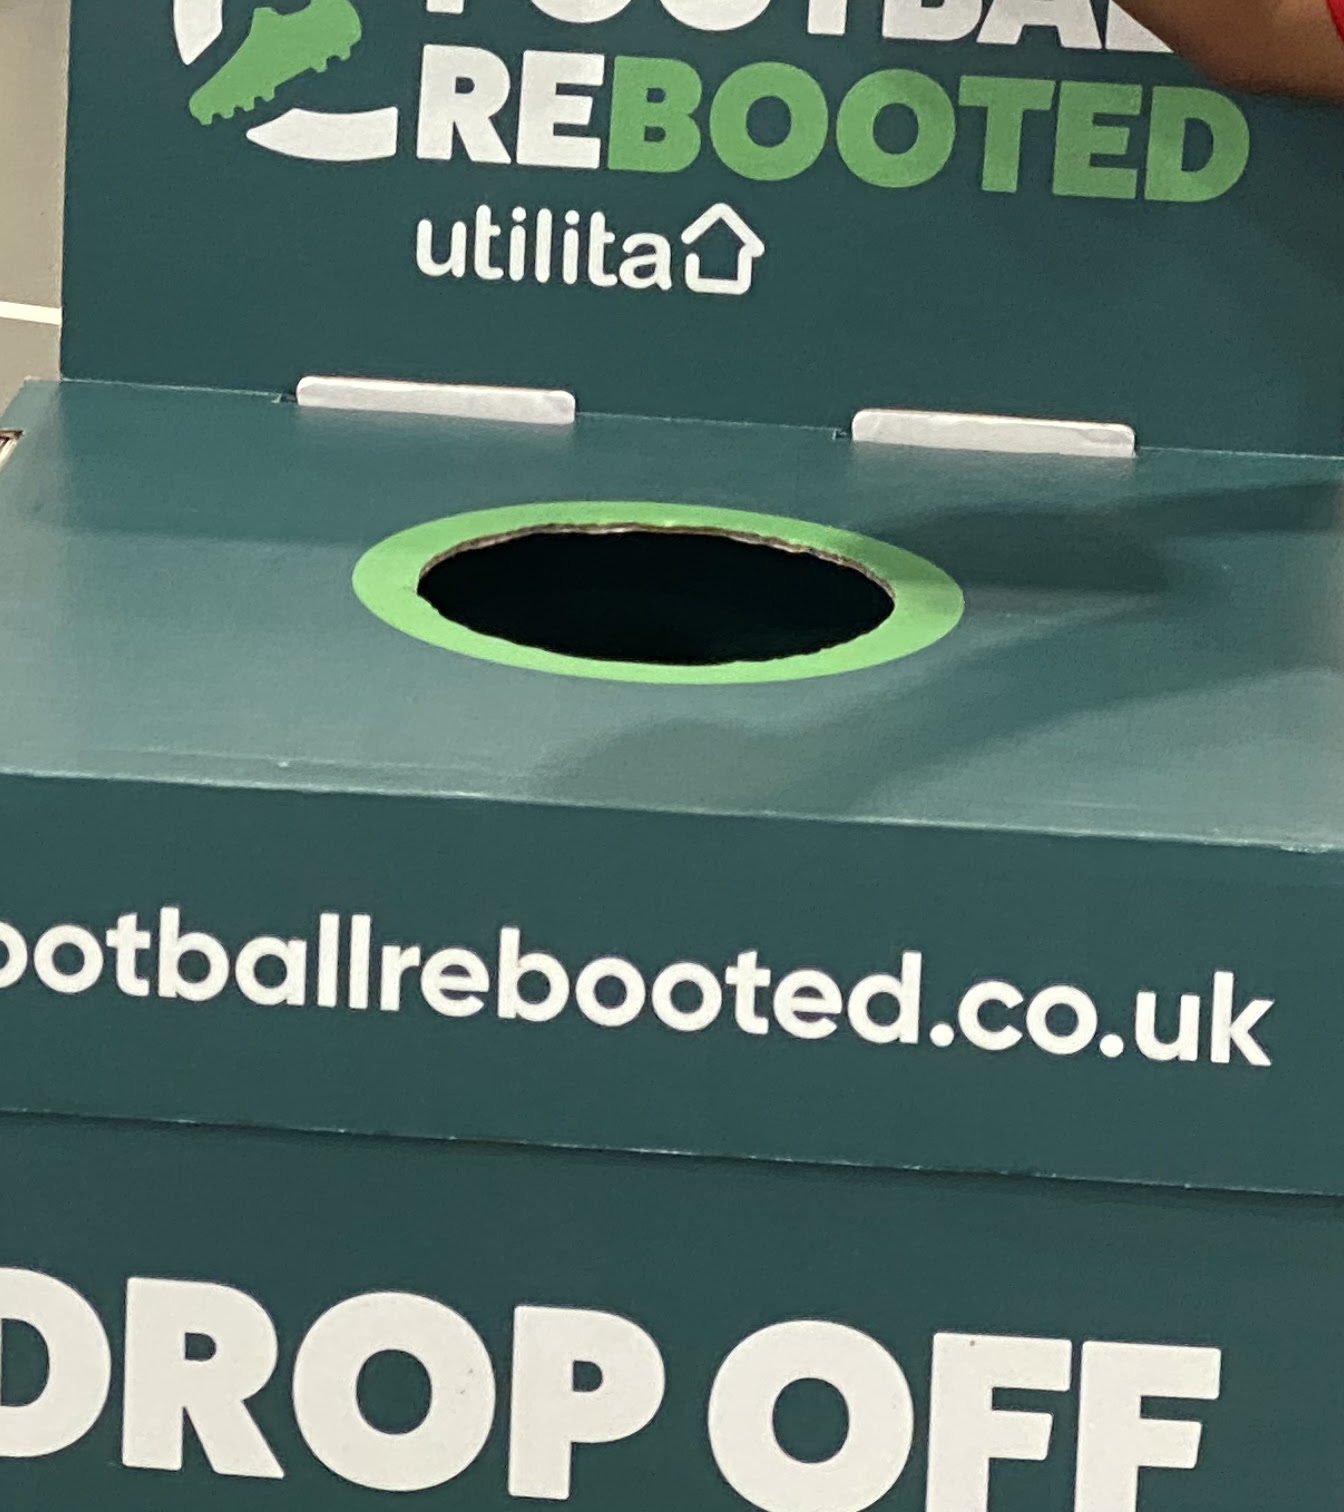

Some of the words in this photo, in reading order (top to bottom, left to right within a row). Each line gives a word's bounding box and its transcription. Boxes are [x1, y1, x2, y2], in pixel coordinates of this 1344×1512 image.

[416, 44, 1251, 204] REBOOTED
[416, 203, 674, 291] utilita
[707, 1319, 1223, 1512] OFF
